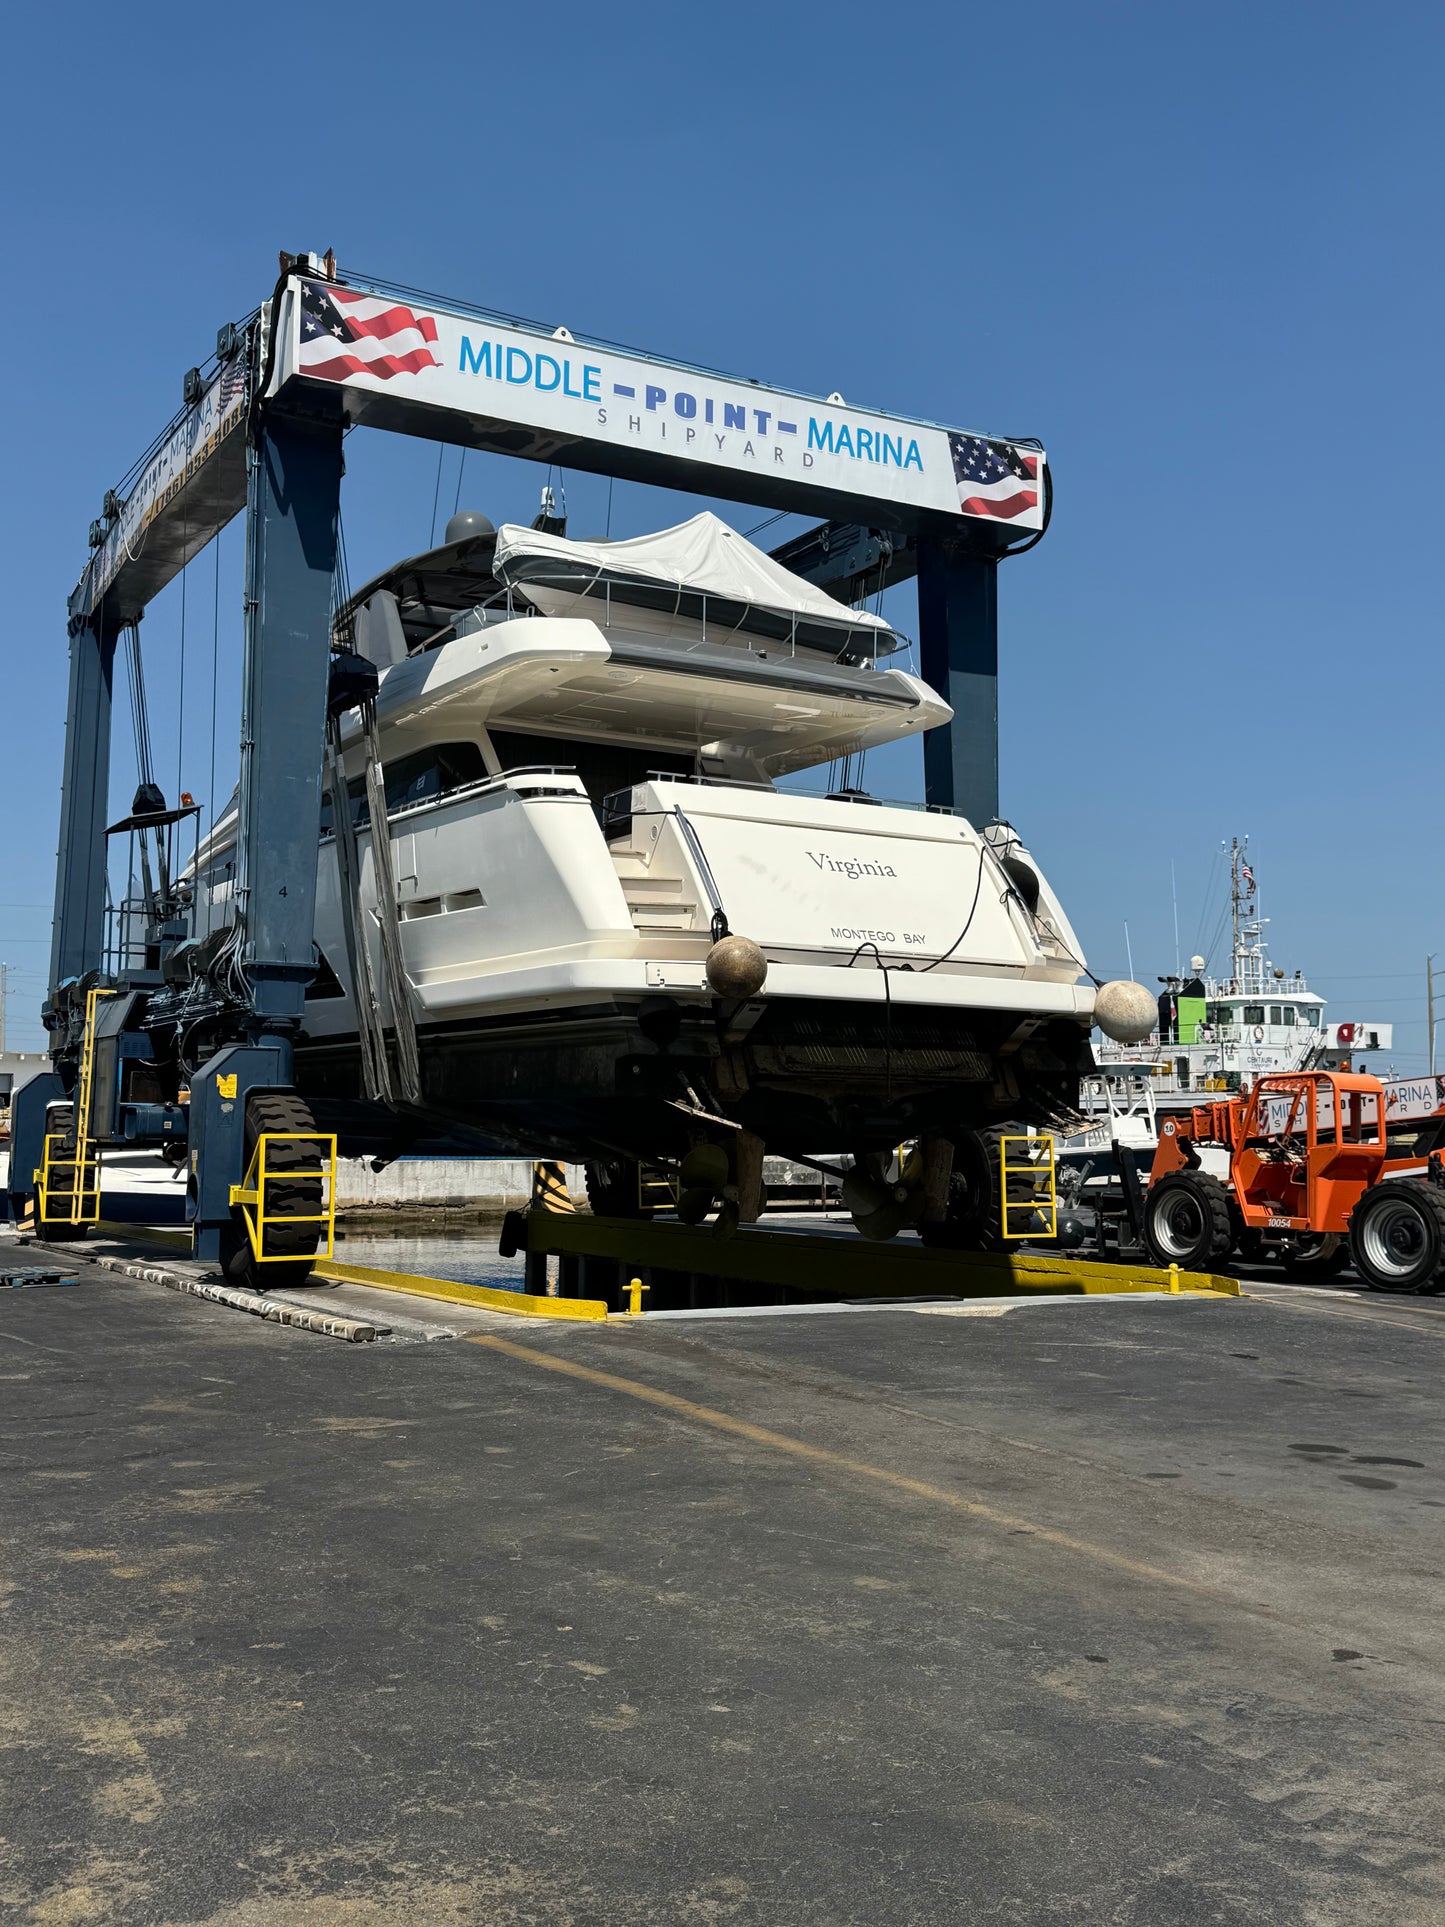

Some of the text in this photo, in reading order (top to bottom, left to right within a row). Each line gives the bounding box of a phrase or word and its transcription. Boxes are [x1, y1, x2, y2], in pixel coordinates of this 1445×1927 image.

[459, 336, 601, 402] MIDDLE
[807, 417, 924, 471] MARINA
[170, 395, 212, 464] MARINA
[598, 408, 814, 467] SHIPYARD
[805, 851, 897, 880] Virginia
[279, 886, 288, 898] 4
[830, 927, 926, 944] MONTEGO BAY
[1268, 1218, 1291, 1228] 10054
